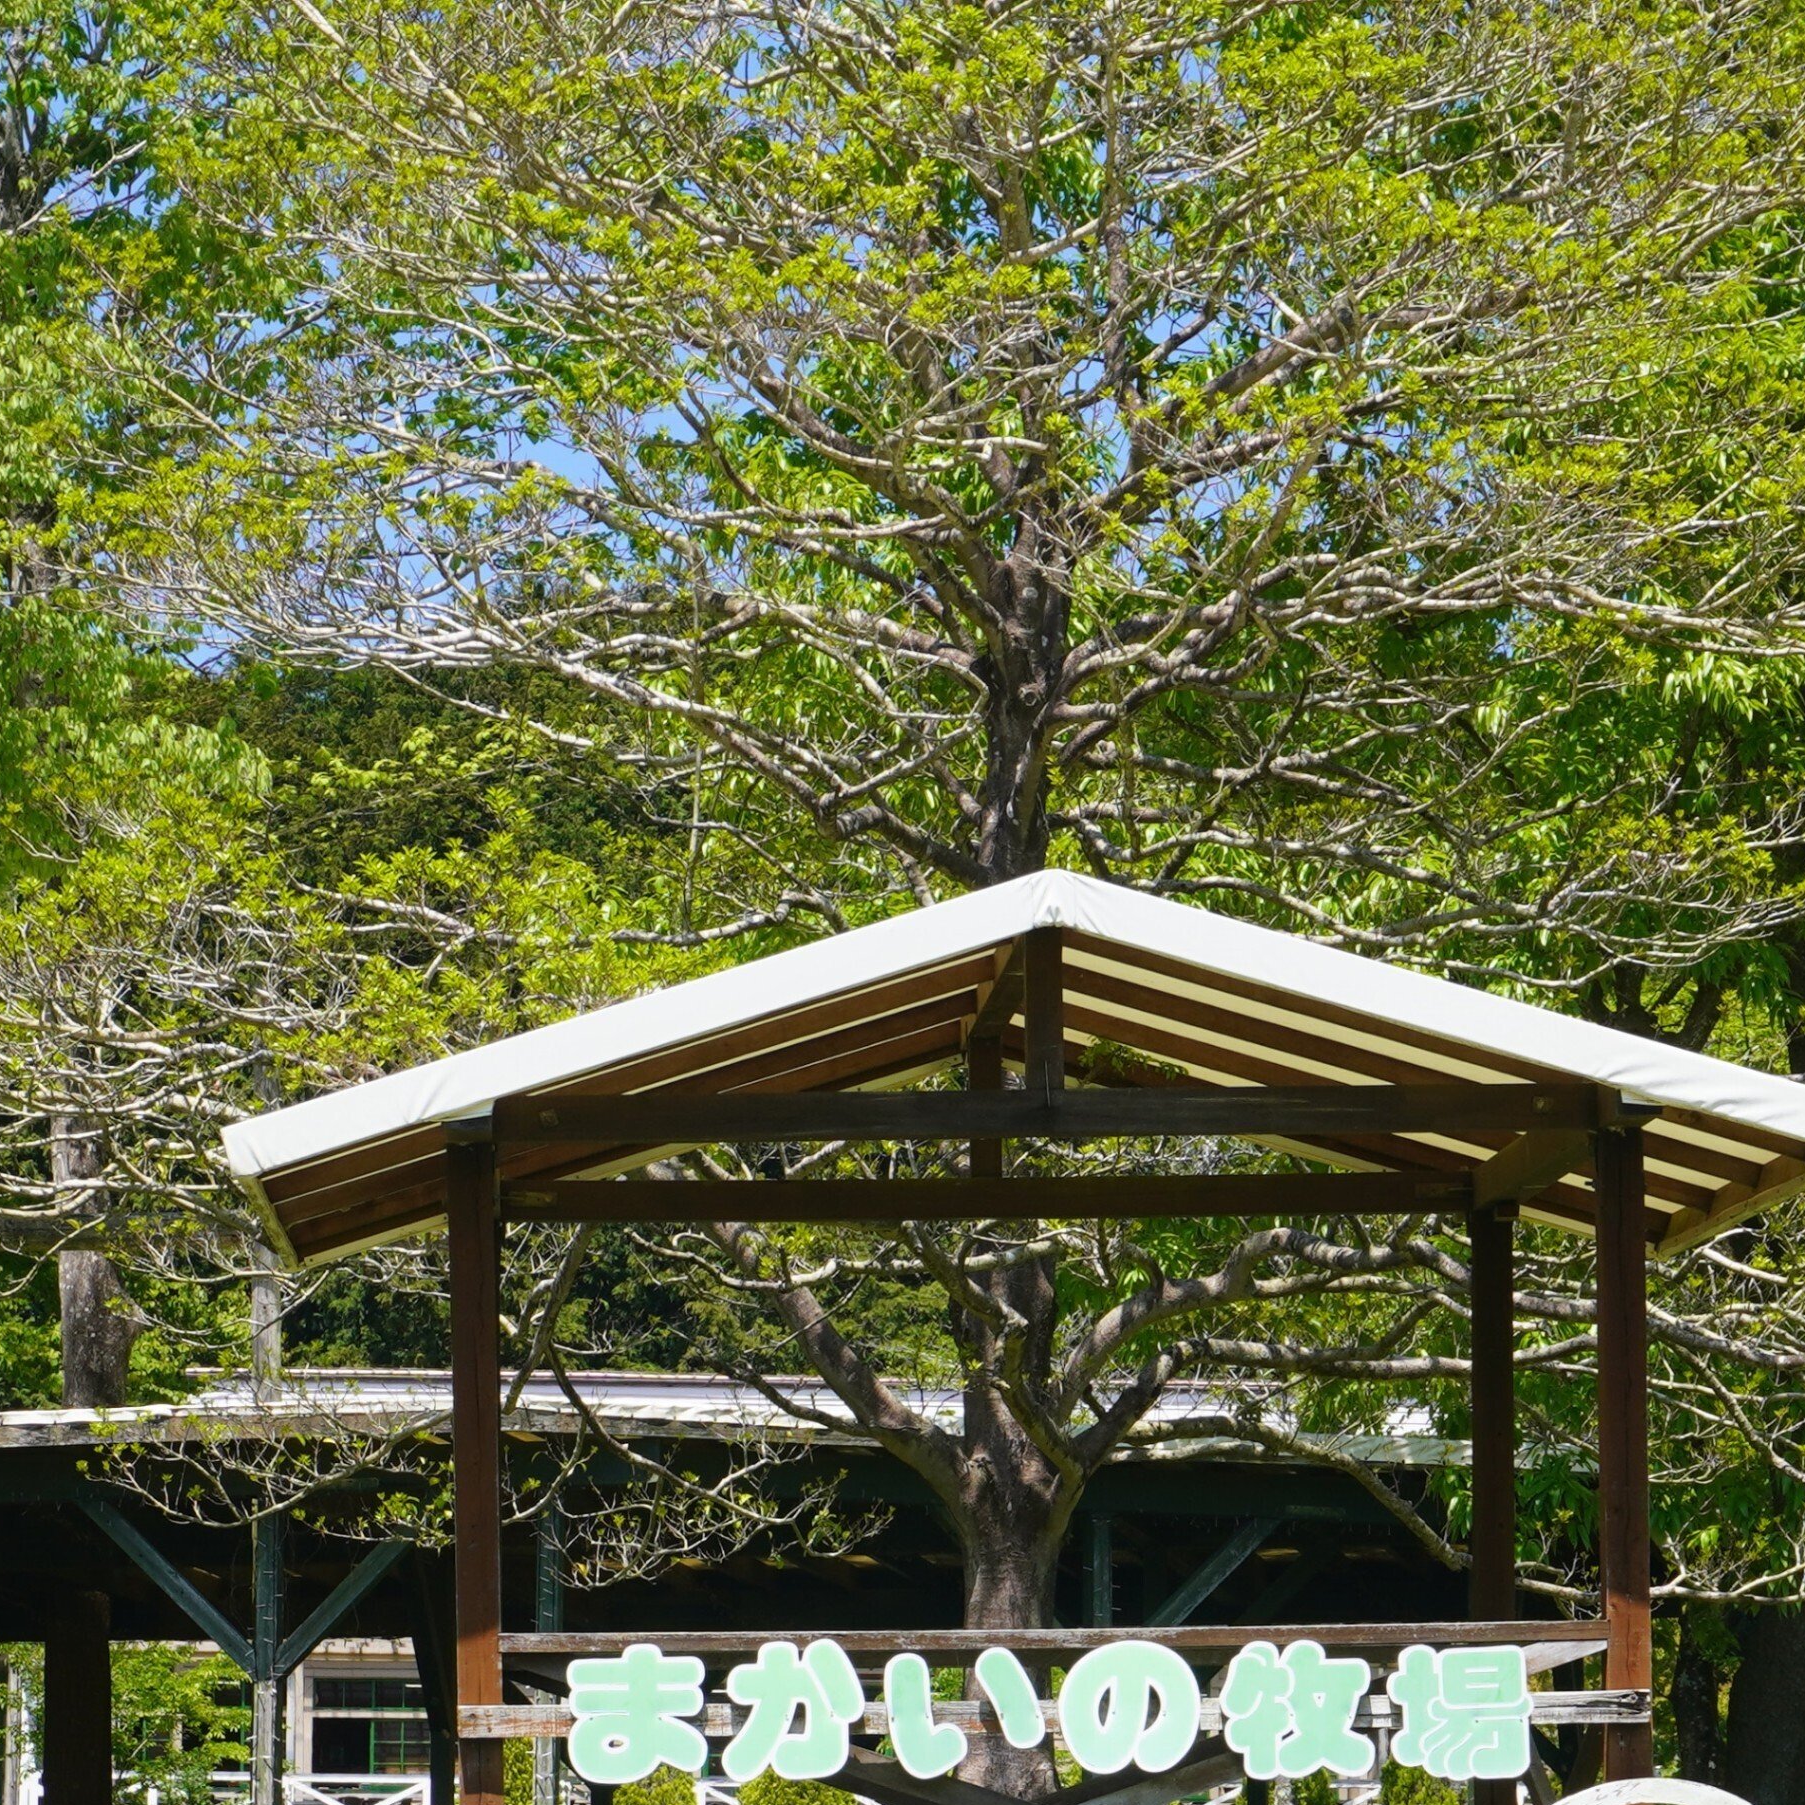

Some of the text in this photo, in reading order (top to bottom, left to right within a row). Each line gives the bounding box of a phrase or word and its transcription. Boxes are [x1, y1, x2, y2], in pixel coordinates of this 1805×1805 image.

[566, 1638, 1531, 1785] まかいの牧場
